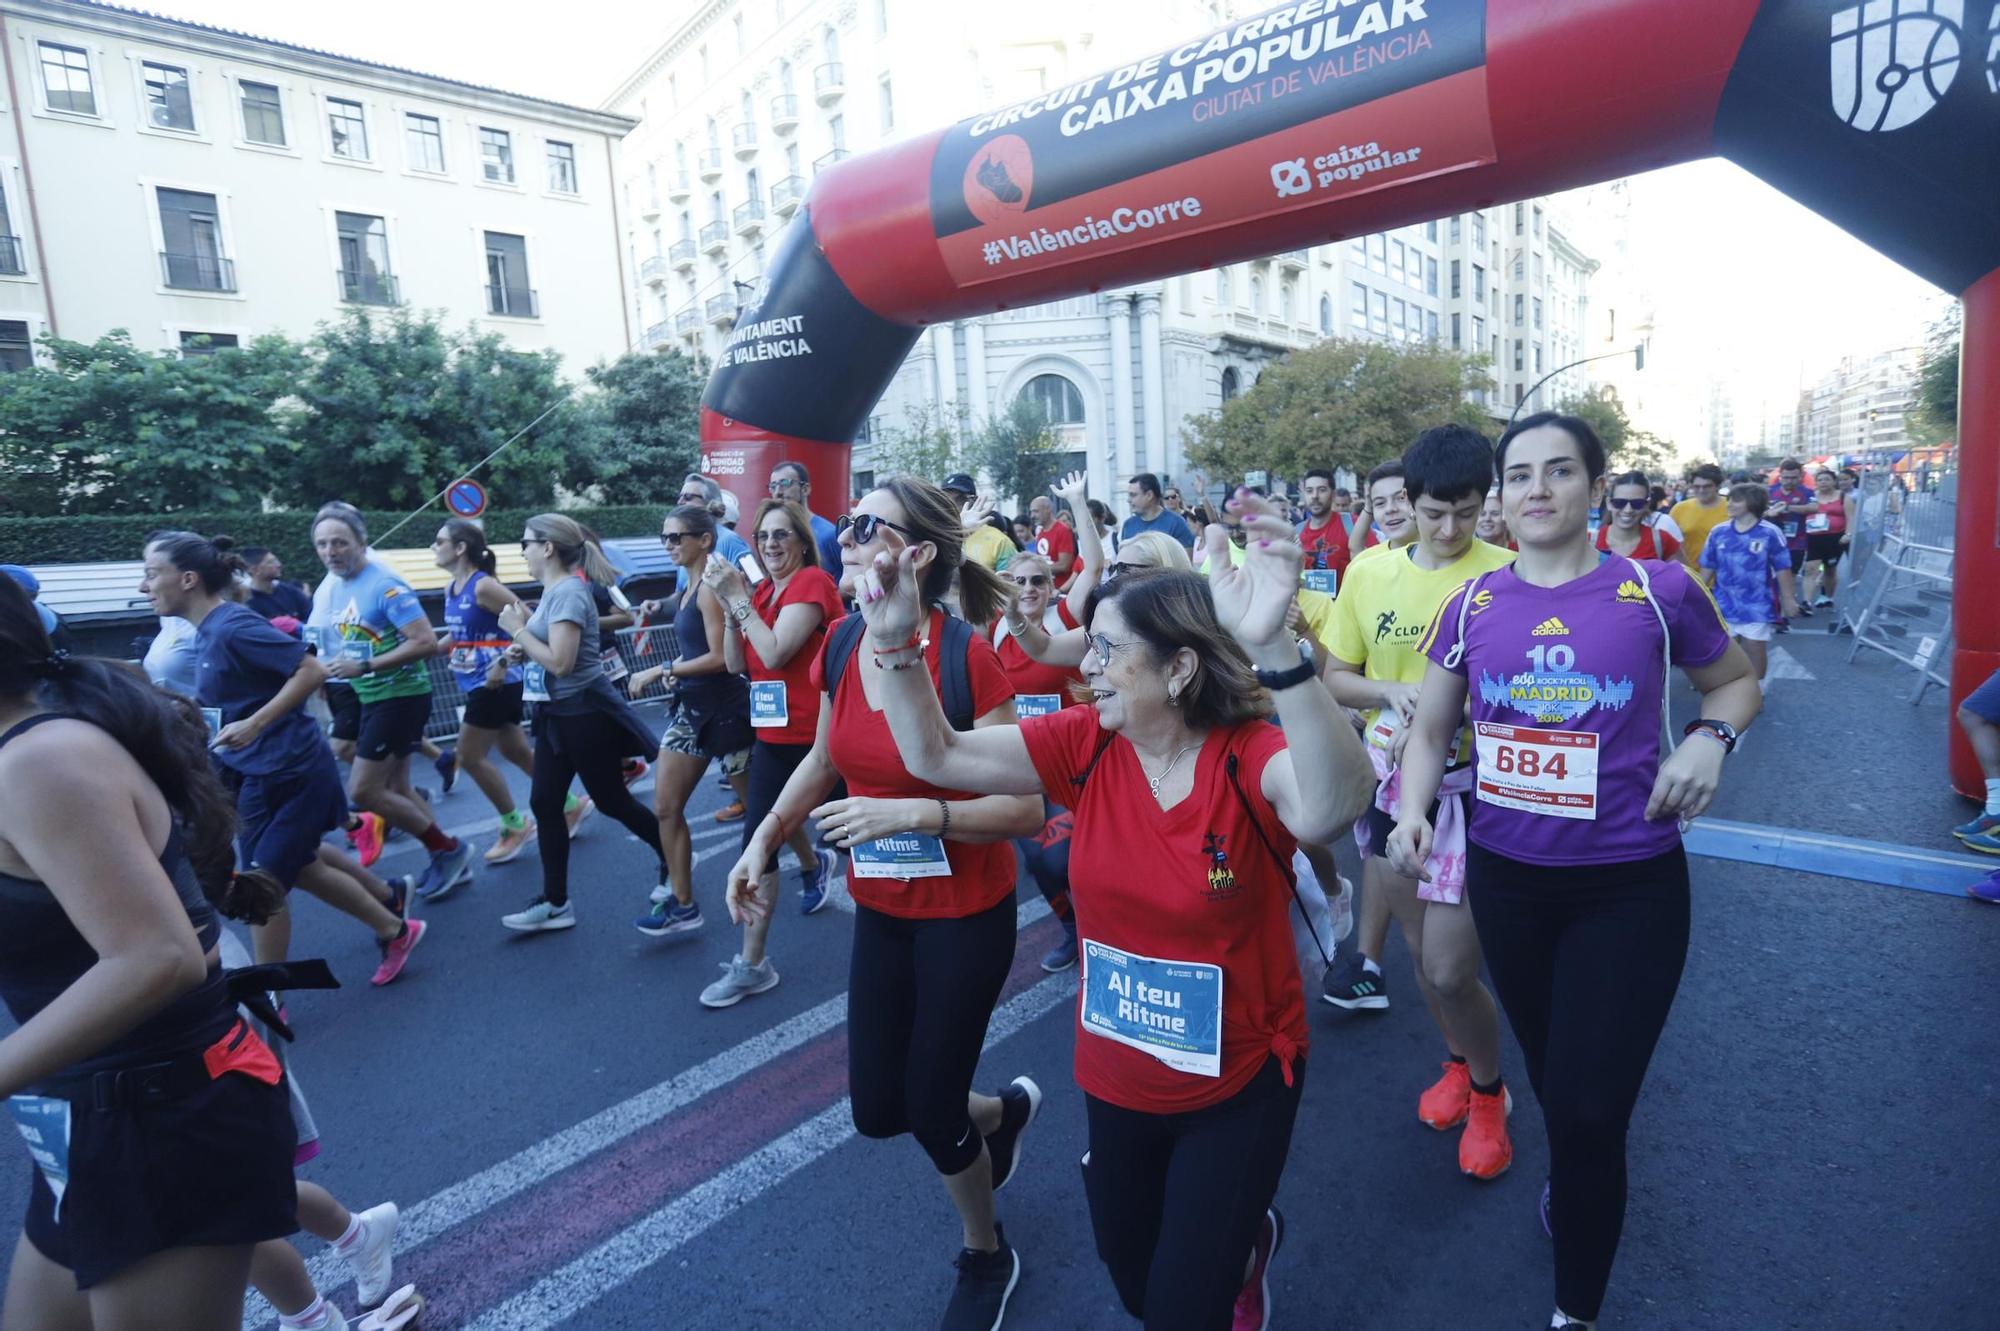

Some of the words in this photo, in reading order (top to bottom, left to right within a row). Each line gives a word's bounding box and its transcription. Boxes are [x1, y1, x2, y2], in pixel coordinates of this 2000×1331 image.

[1060, 71, 1187, 137] CAIXA
[1191, 0, 1428, 96] POPULAR
[1192, 81, 1265, 122] CIUTAT
[1271, 70, 1302, 98] DE
[1308, 29, 1432, 86] VALÈNCIA
[969, 76, 1104, 137] CIRCUIT
[1108, 55, 1164, 90] DE
[1313, 141, 1380, 171] caixa
[1316, 146, 1422, 188] popular
[982, 197, 1202, 266] #ValènciaCorre
[734, 338, 813, 364] VALÈNCIA
[1532, 628, 1569, 636] adidas
[1526, 644, 1575, 673] 10
[1512, 672, 1535, 687] edp
[1510, 687, 1593, 702] MADRID
[1541, 703, 1561, 712] 10K
[1016, 704, 1026, 715] Al
[1028, 705, 1046, 715] teu
[1536, 714, 1565, 723] 2016
[1496, 745, 1568, 780] 684
[874, 838, 921, 852] Ritme
[1107, 970, 1131, 999] Al
[1136, 981, 1181, 1009] teu
[1118, 997, 1185, 1034] Ritme
